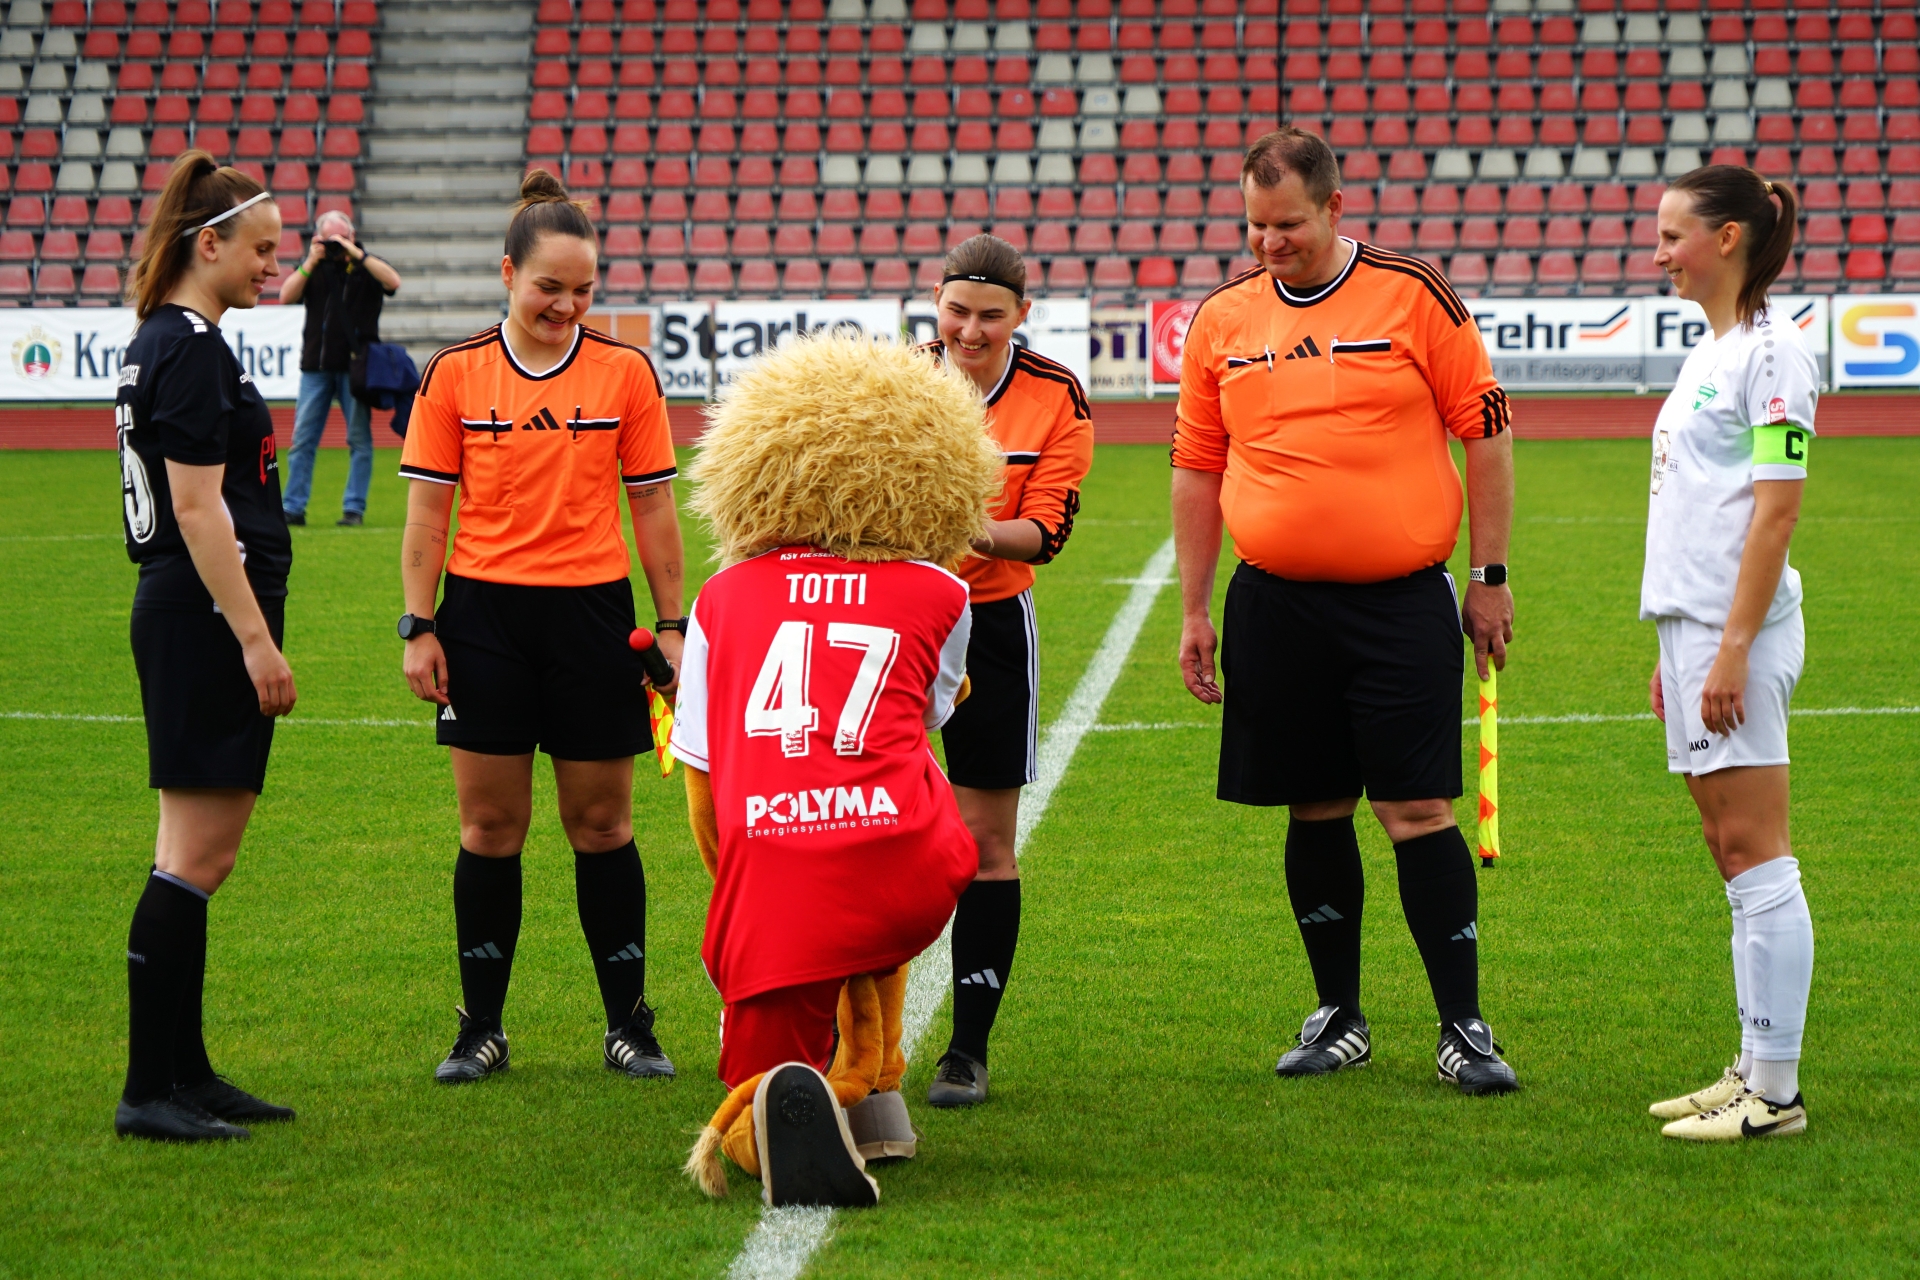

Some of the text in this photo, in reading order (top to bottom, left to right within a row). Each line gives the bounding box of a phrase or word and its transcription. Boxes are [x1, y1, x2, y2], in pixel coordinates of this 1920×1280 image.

[1656, 312, 1706, 349] Fe
[1528, 361, 1643, 382] Entsorgung
[1785, 430, 1804, 461] C
[780, 553, 798, 561] KSV
[786, 573, 867, 605] TOTTI
[744, 621, 900, 758] 47
[746, 786, 899, 828] POLYMA
[747, 817, 898, 838] Energiesysteme GmbH
